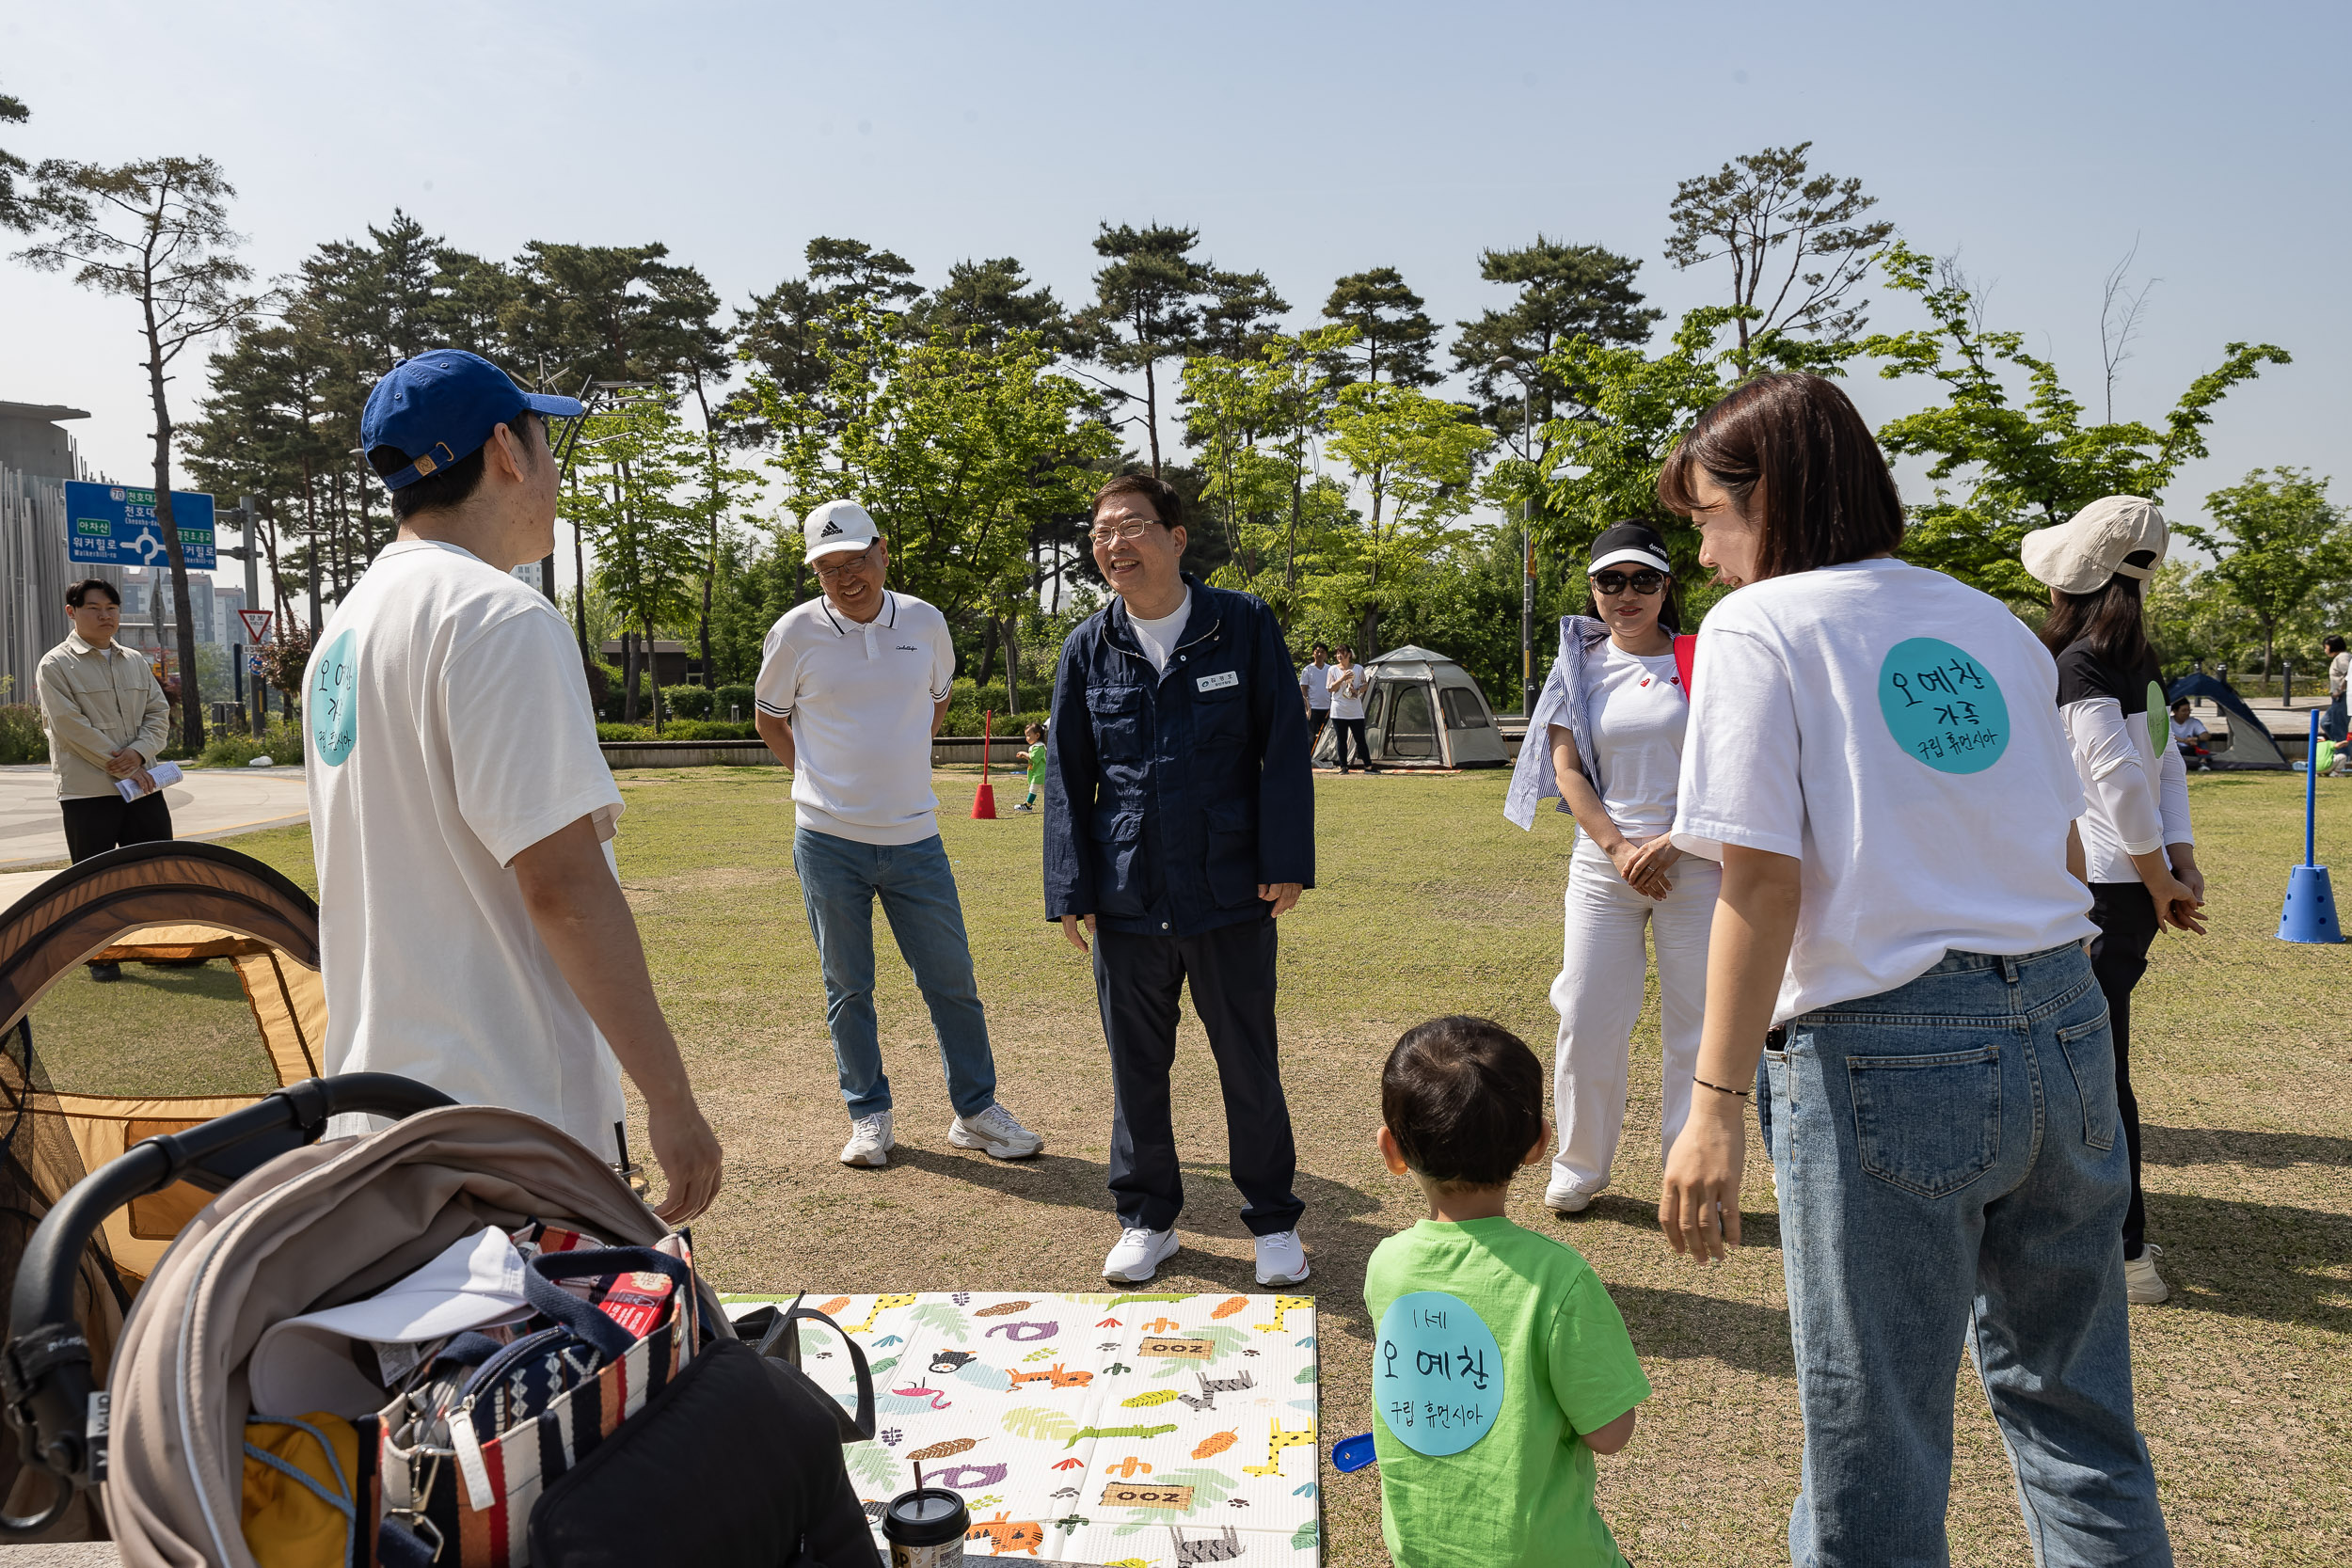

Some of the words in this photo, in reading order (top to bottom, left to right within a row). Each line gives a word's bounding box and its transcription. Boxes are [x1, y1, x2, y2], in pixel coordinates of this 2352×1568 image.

[112, 491, 123, 499] 70
[124, 505, 155, 517] 천호대
[79, 521, 108, 533] 아차산
[820, 529, 843, 539] adidas
[72, 537, 117, 551] 워커힐로
[1933, 701, 1980, 726] 가족
[1917, 736, 1945, 760] 구립
[1946, 729, 2000, 755] 휴먼시아
[1391, 1400, 1415, 1428] 구립
[1423, 1400, 1484, 1430] 휴먼시아
